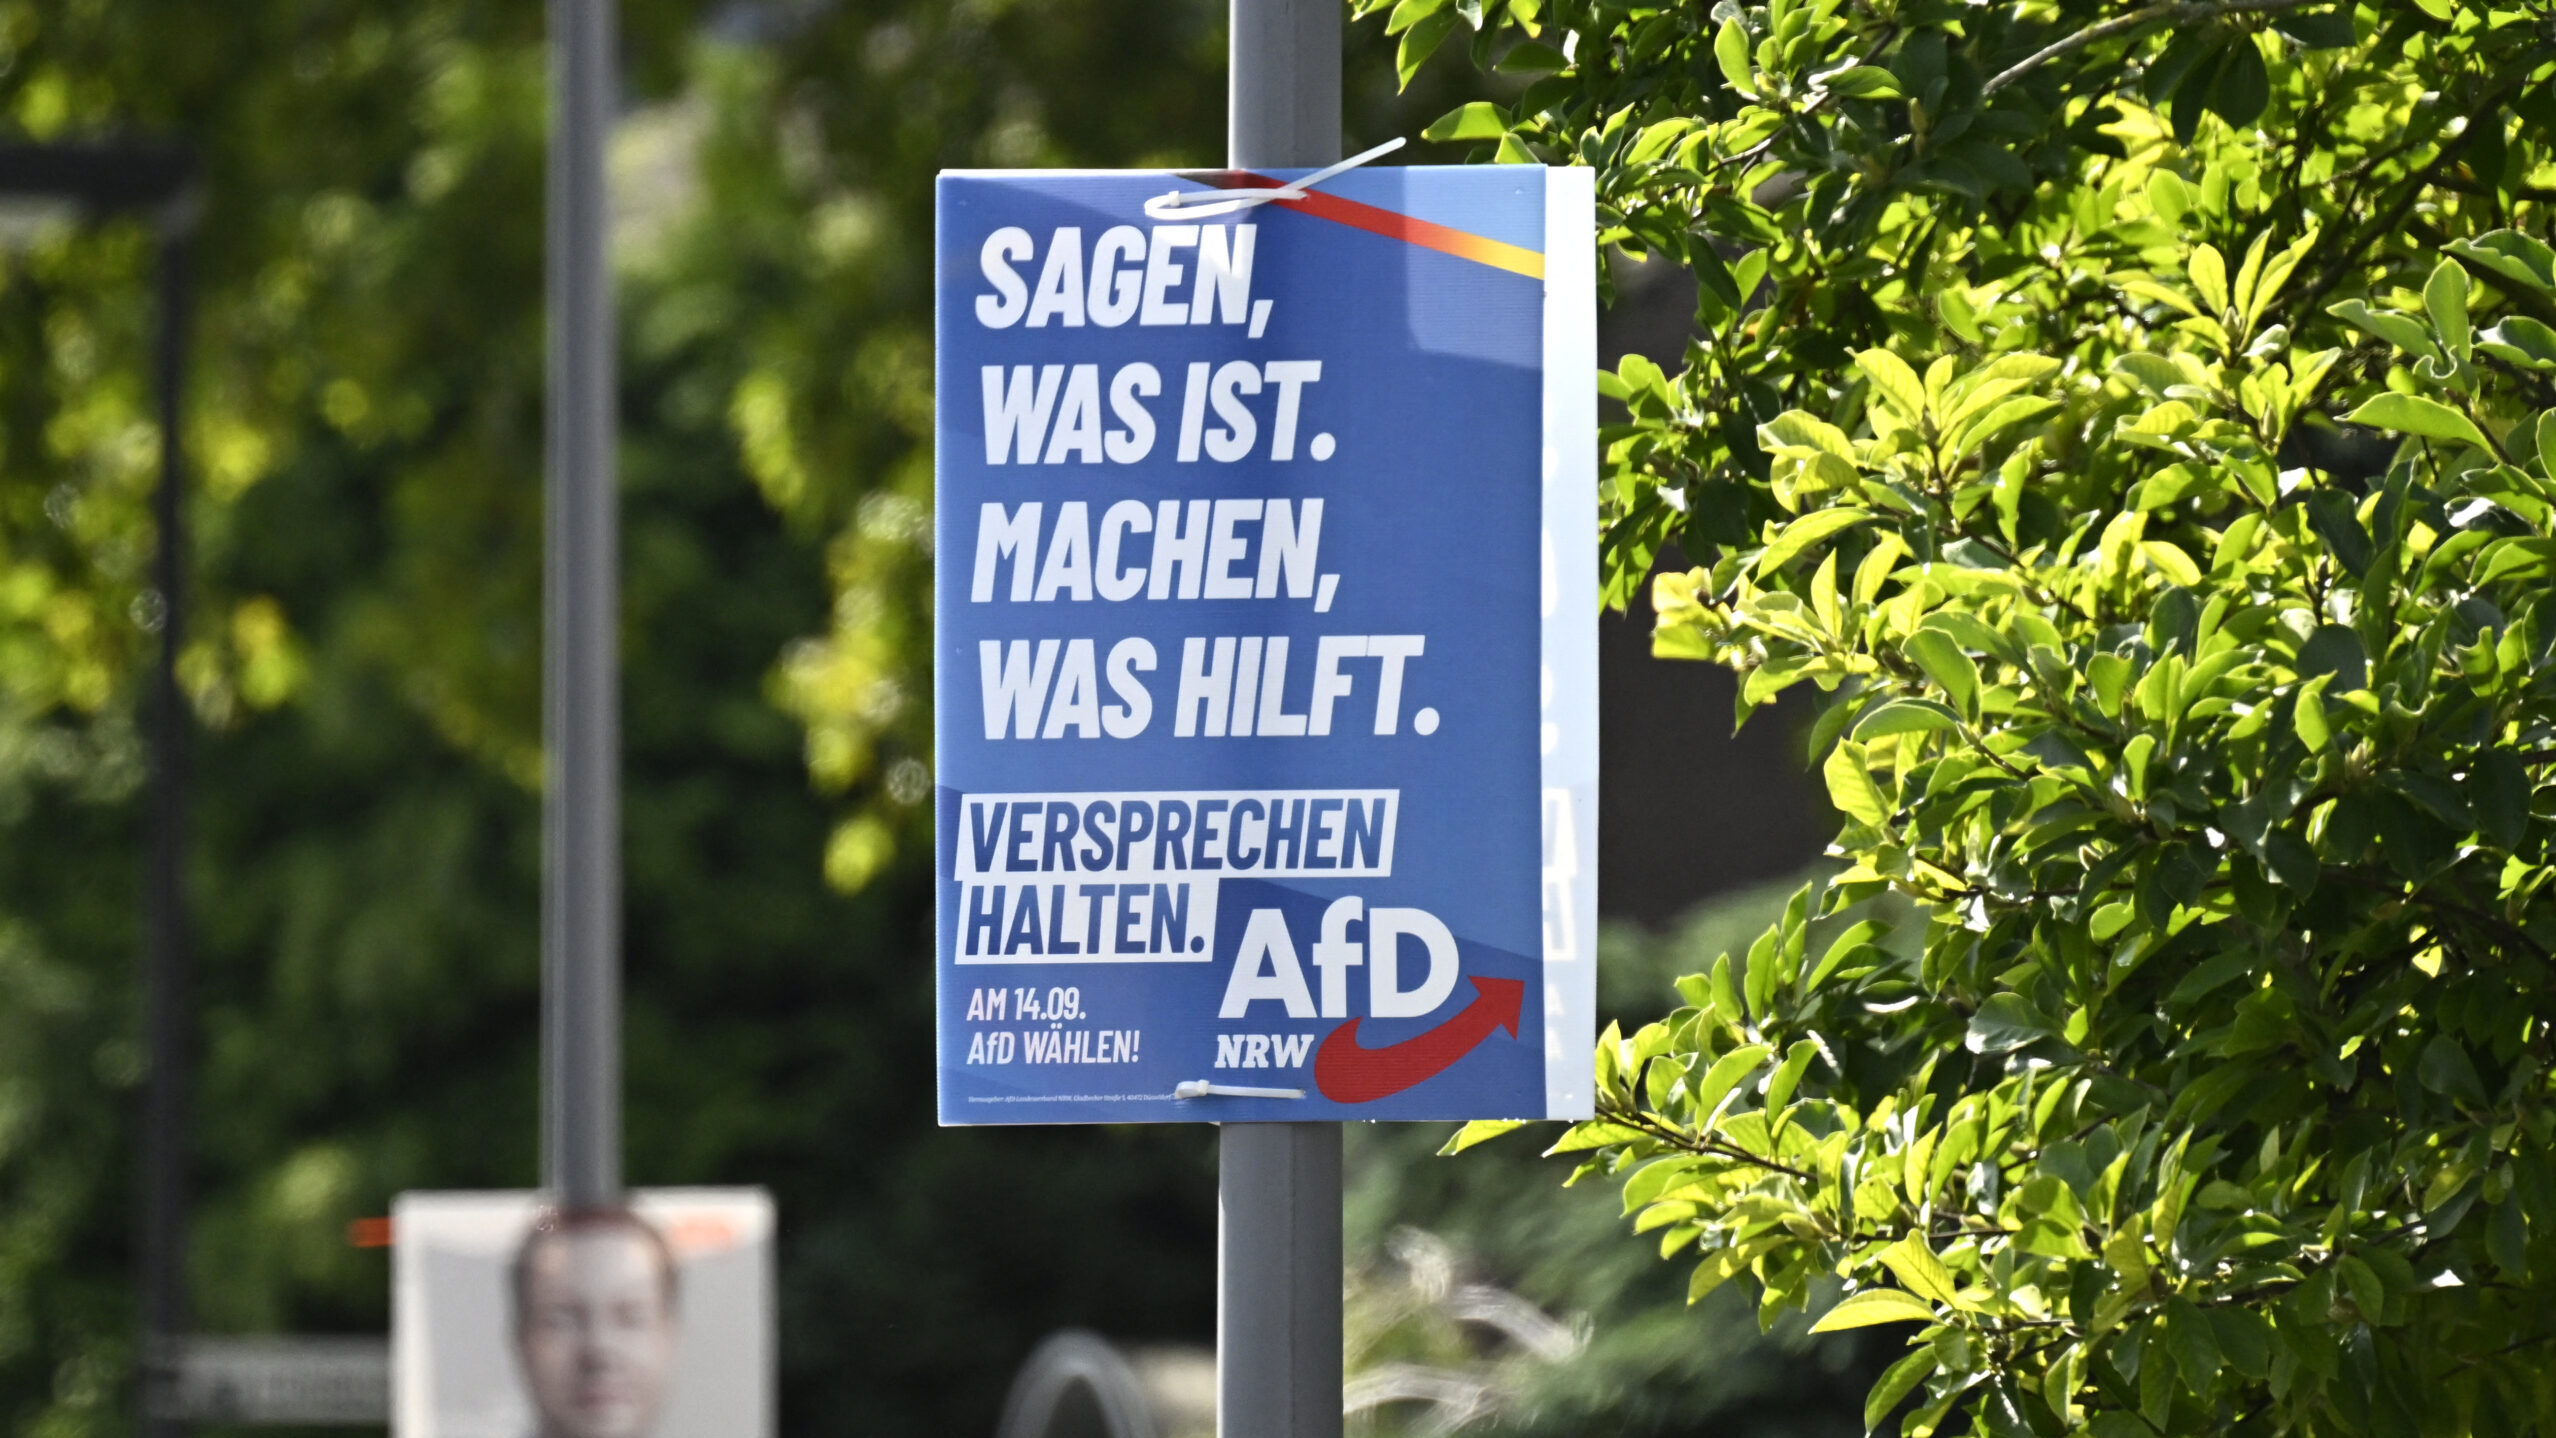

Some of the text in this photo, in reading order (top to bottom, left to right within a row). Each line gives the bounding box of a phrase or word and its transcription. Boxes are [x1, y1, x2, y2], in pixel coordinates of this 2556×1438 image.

[975, 223, 1273, 338] SAGEN,
[981, 360, 1336, 464] WAS IST.
[971, 498, 1340, 612] MACHEN,
[979, 634, 1440, 739] WAS HILFT.
[969, 798, 1387, 873] VERSPRECHEN
[965, 883, 1206, 955] HALTEN.
[1218, 896, 1460, 1018] AfD
[967, 987, 1087, 1021] AM 14.09.
[967, 1022, 1140, 1065] AfD WÄHLEN!
[1214, 1034, 1315, 1069] NRW
